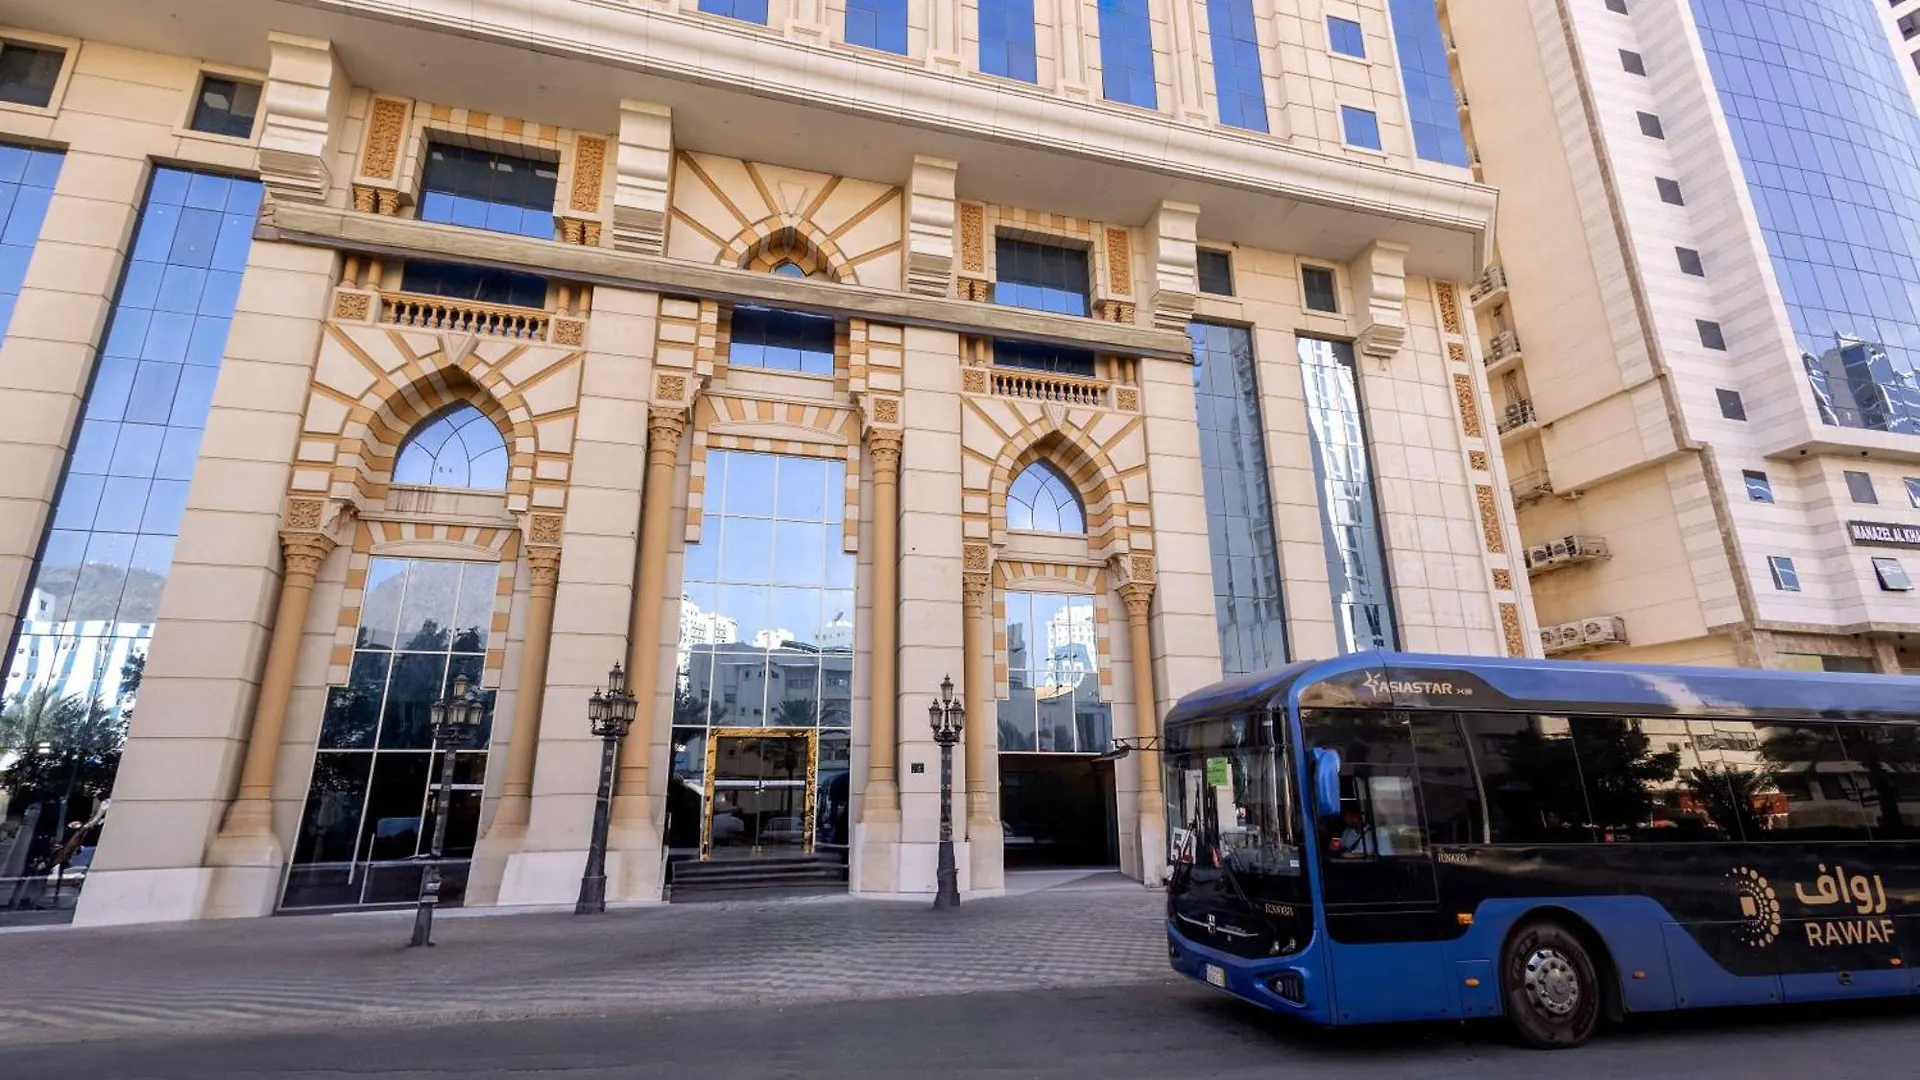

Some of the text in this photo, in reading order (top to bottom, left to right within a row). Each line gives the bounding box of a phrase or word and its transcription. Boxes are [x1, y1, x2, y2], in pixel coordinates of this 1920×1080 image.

[1852, 525, 1895, 542] MANAZEL
[1893, 527, 1905, 542] AL
[1379, 681, 1454, 695] ASIASTAR
[1795, 863, 1887, 914] رواف
[1804, 919, 1895, 947] RAWAF
